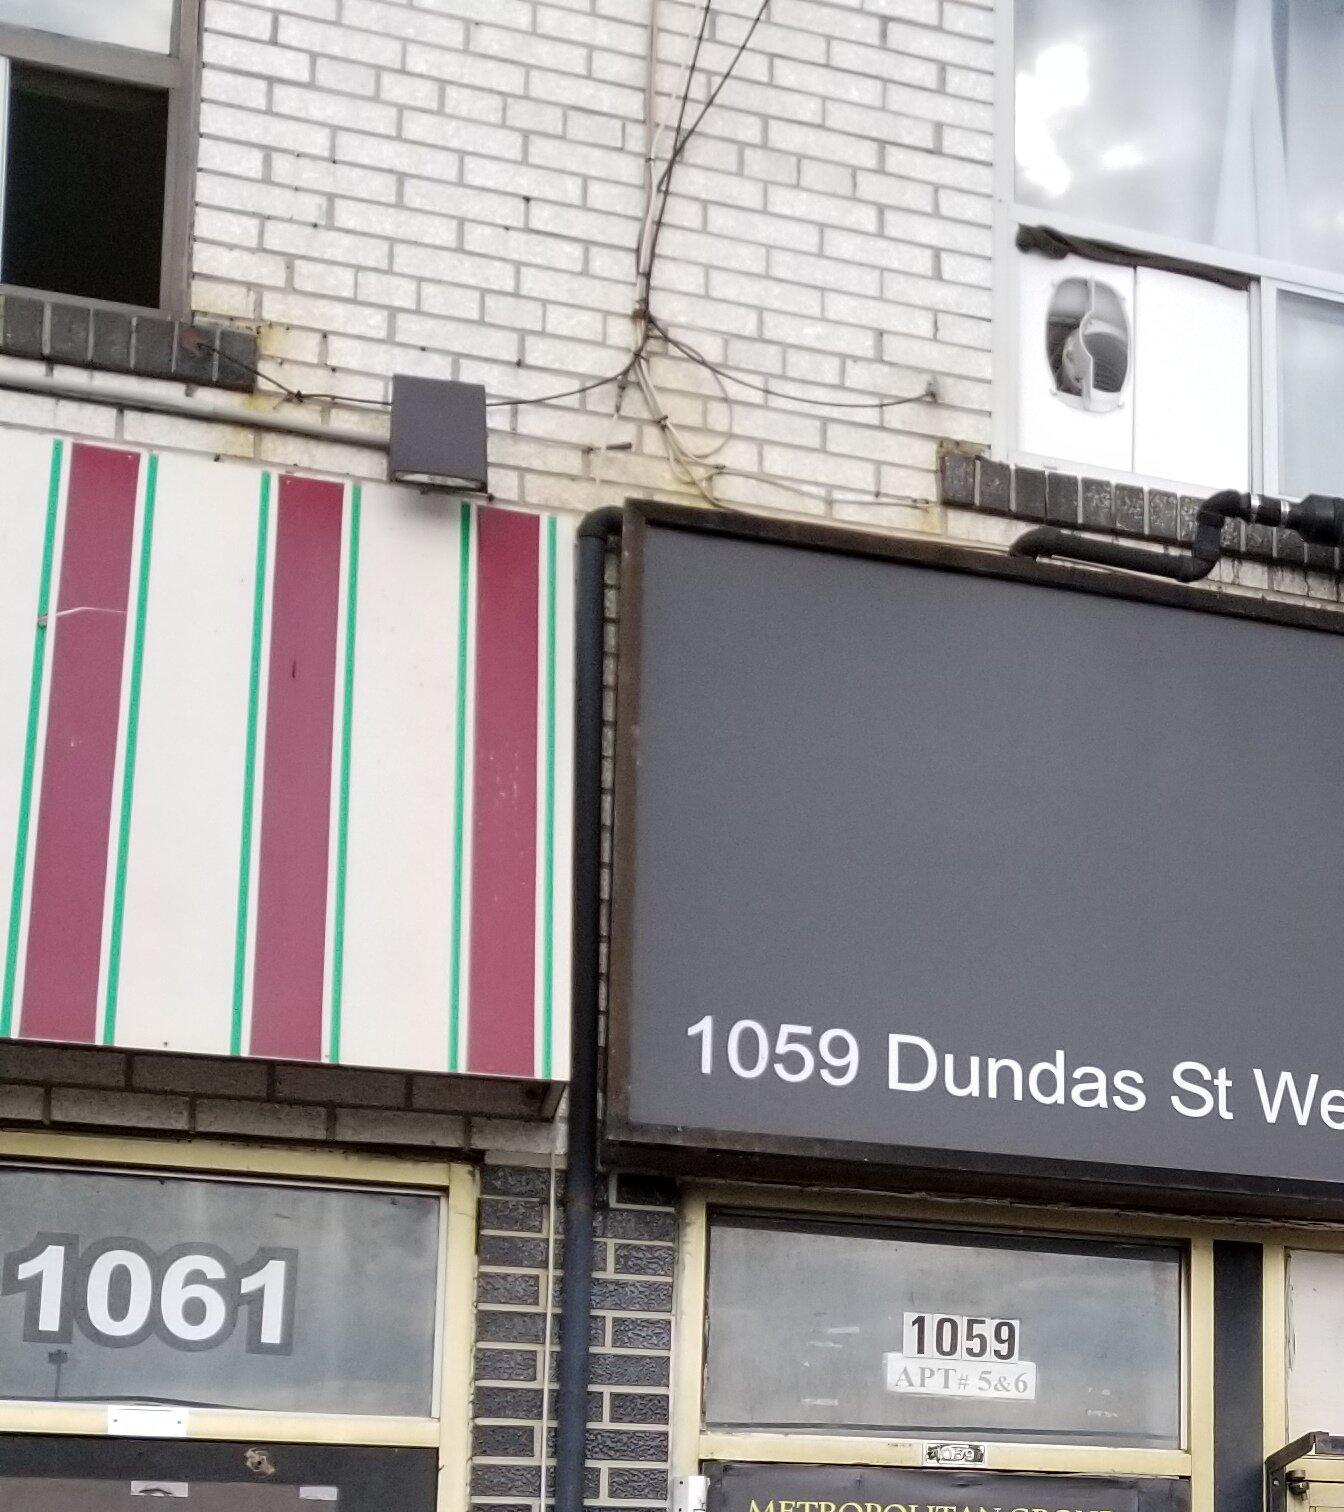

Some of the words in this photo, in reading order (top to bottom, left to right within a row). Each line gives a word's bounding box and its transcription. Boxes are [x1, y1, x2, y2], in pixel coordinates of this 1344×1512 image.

[687, 1015, 860, 1087] 1059
[888, 1032, 1146, 1113] Dundas
[1170, 1060, 1234, 1121] St
[14, 1242, 289, 1347] 1061
[911, 1315, 1016, 1361] 1059
[977, 1370, 1028, 1393] 5&6
